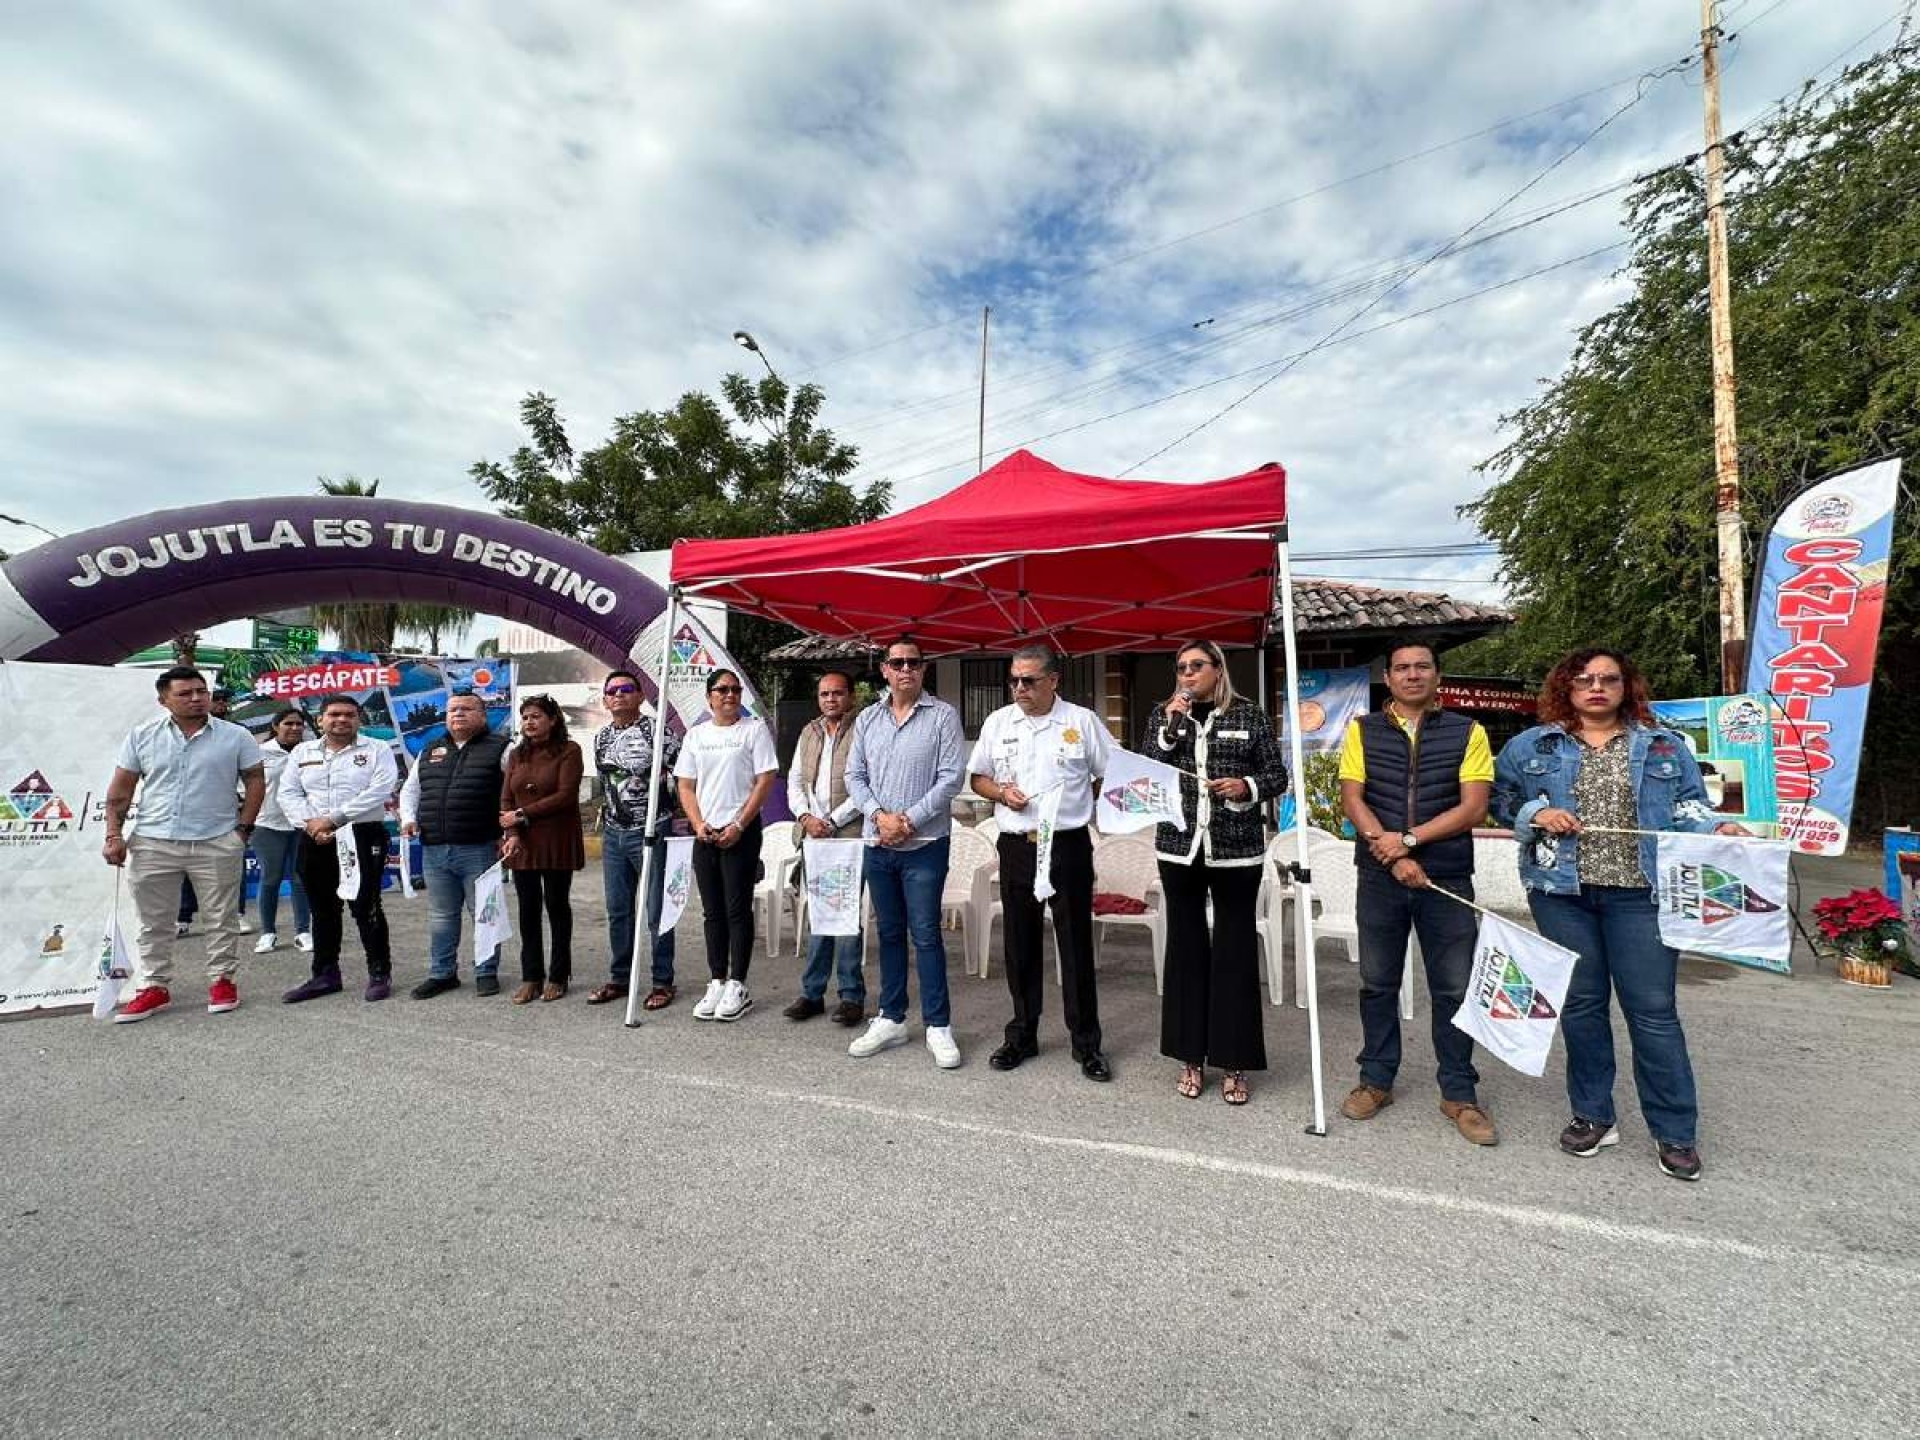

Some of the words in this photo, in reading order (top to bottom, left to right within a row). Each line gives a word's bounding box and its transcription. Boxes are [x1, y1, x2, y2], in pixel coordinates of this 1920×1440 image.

[68, 518, 306, 588] JOJUTLA
[313, 519, 373, 548] ES
[384, 522, 446, 555] TU
[452, 532, 618, 616] DESTINO
[253, 664, 390, 696] #ESCÁPATE
[1436, 687, 1471, 697] CINA
[1766, 537, 1863, 800] CANTARITOS
[1681, 861, 1700, 920] JOJUTLA
